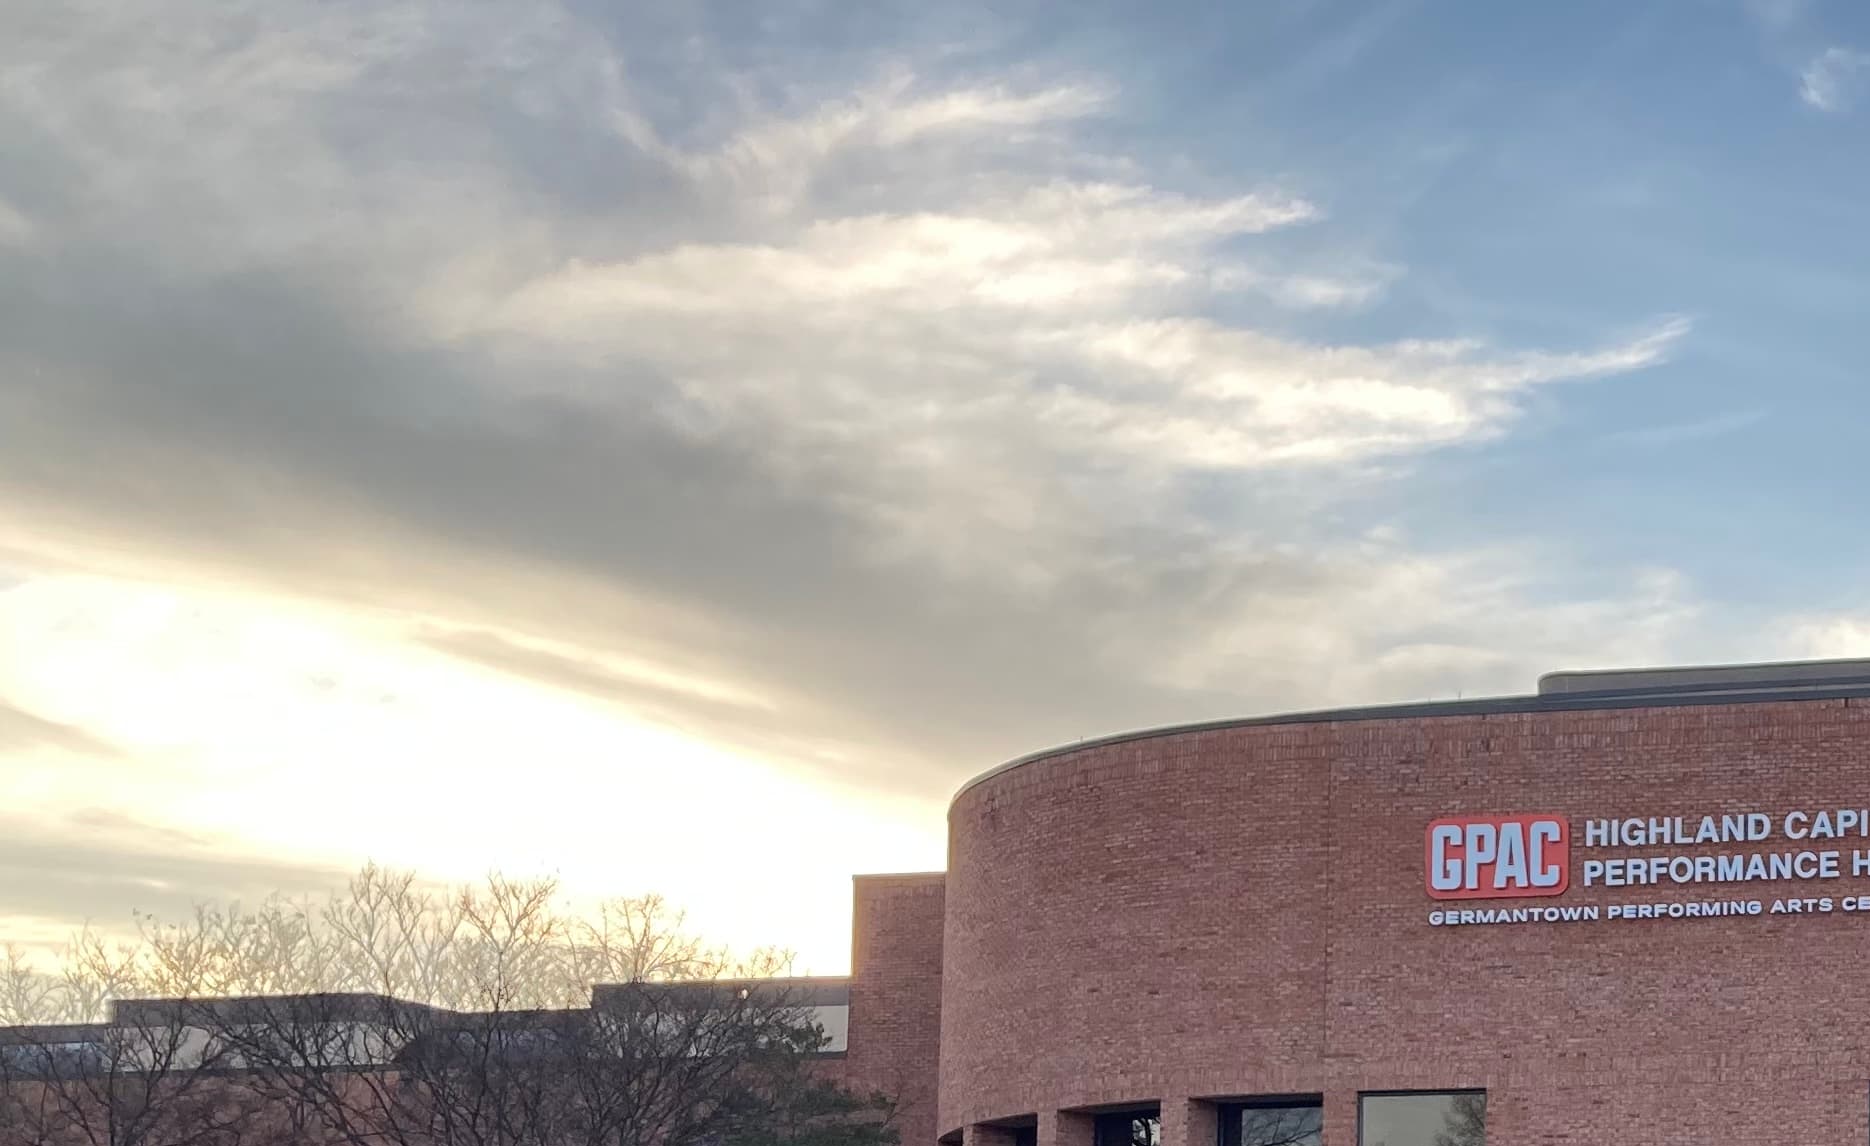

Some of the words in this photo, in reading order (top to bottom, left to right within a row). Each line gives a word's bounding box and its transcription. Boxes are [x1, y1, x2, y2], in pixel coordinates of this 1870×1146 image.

[1585, 812, 1772, 847] HIGHLAND
[1431, 820, 1561, 890] GPAC
[1583, 850, 1841, 887] PERFORMANCE
[1428, 905, 1599, 926] GERMANTOWN
[1607, 899, 1763, 920] PERFORMING
[1769, 897, 1834, 915] ARTS
